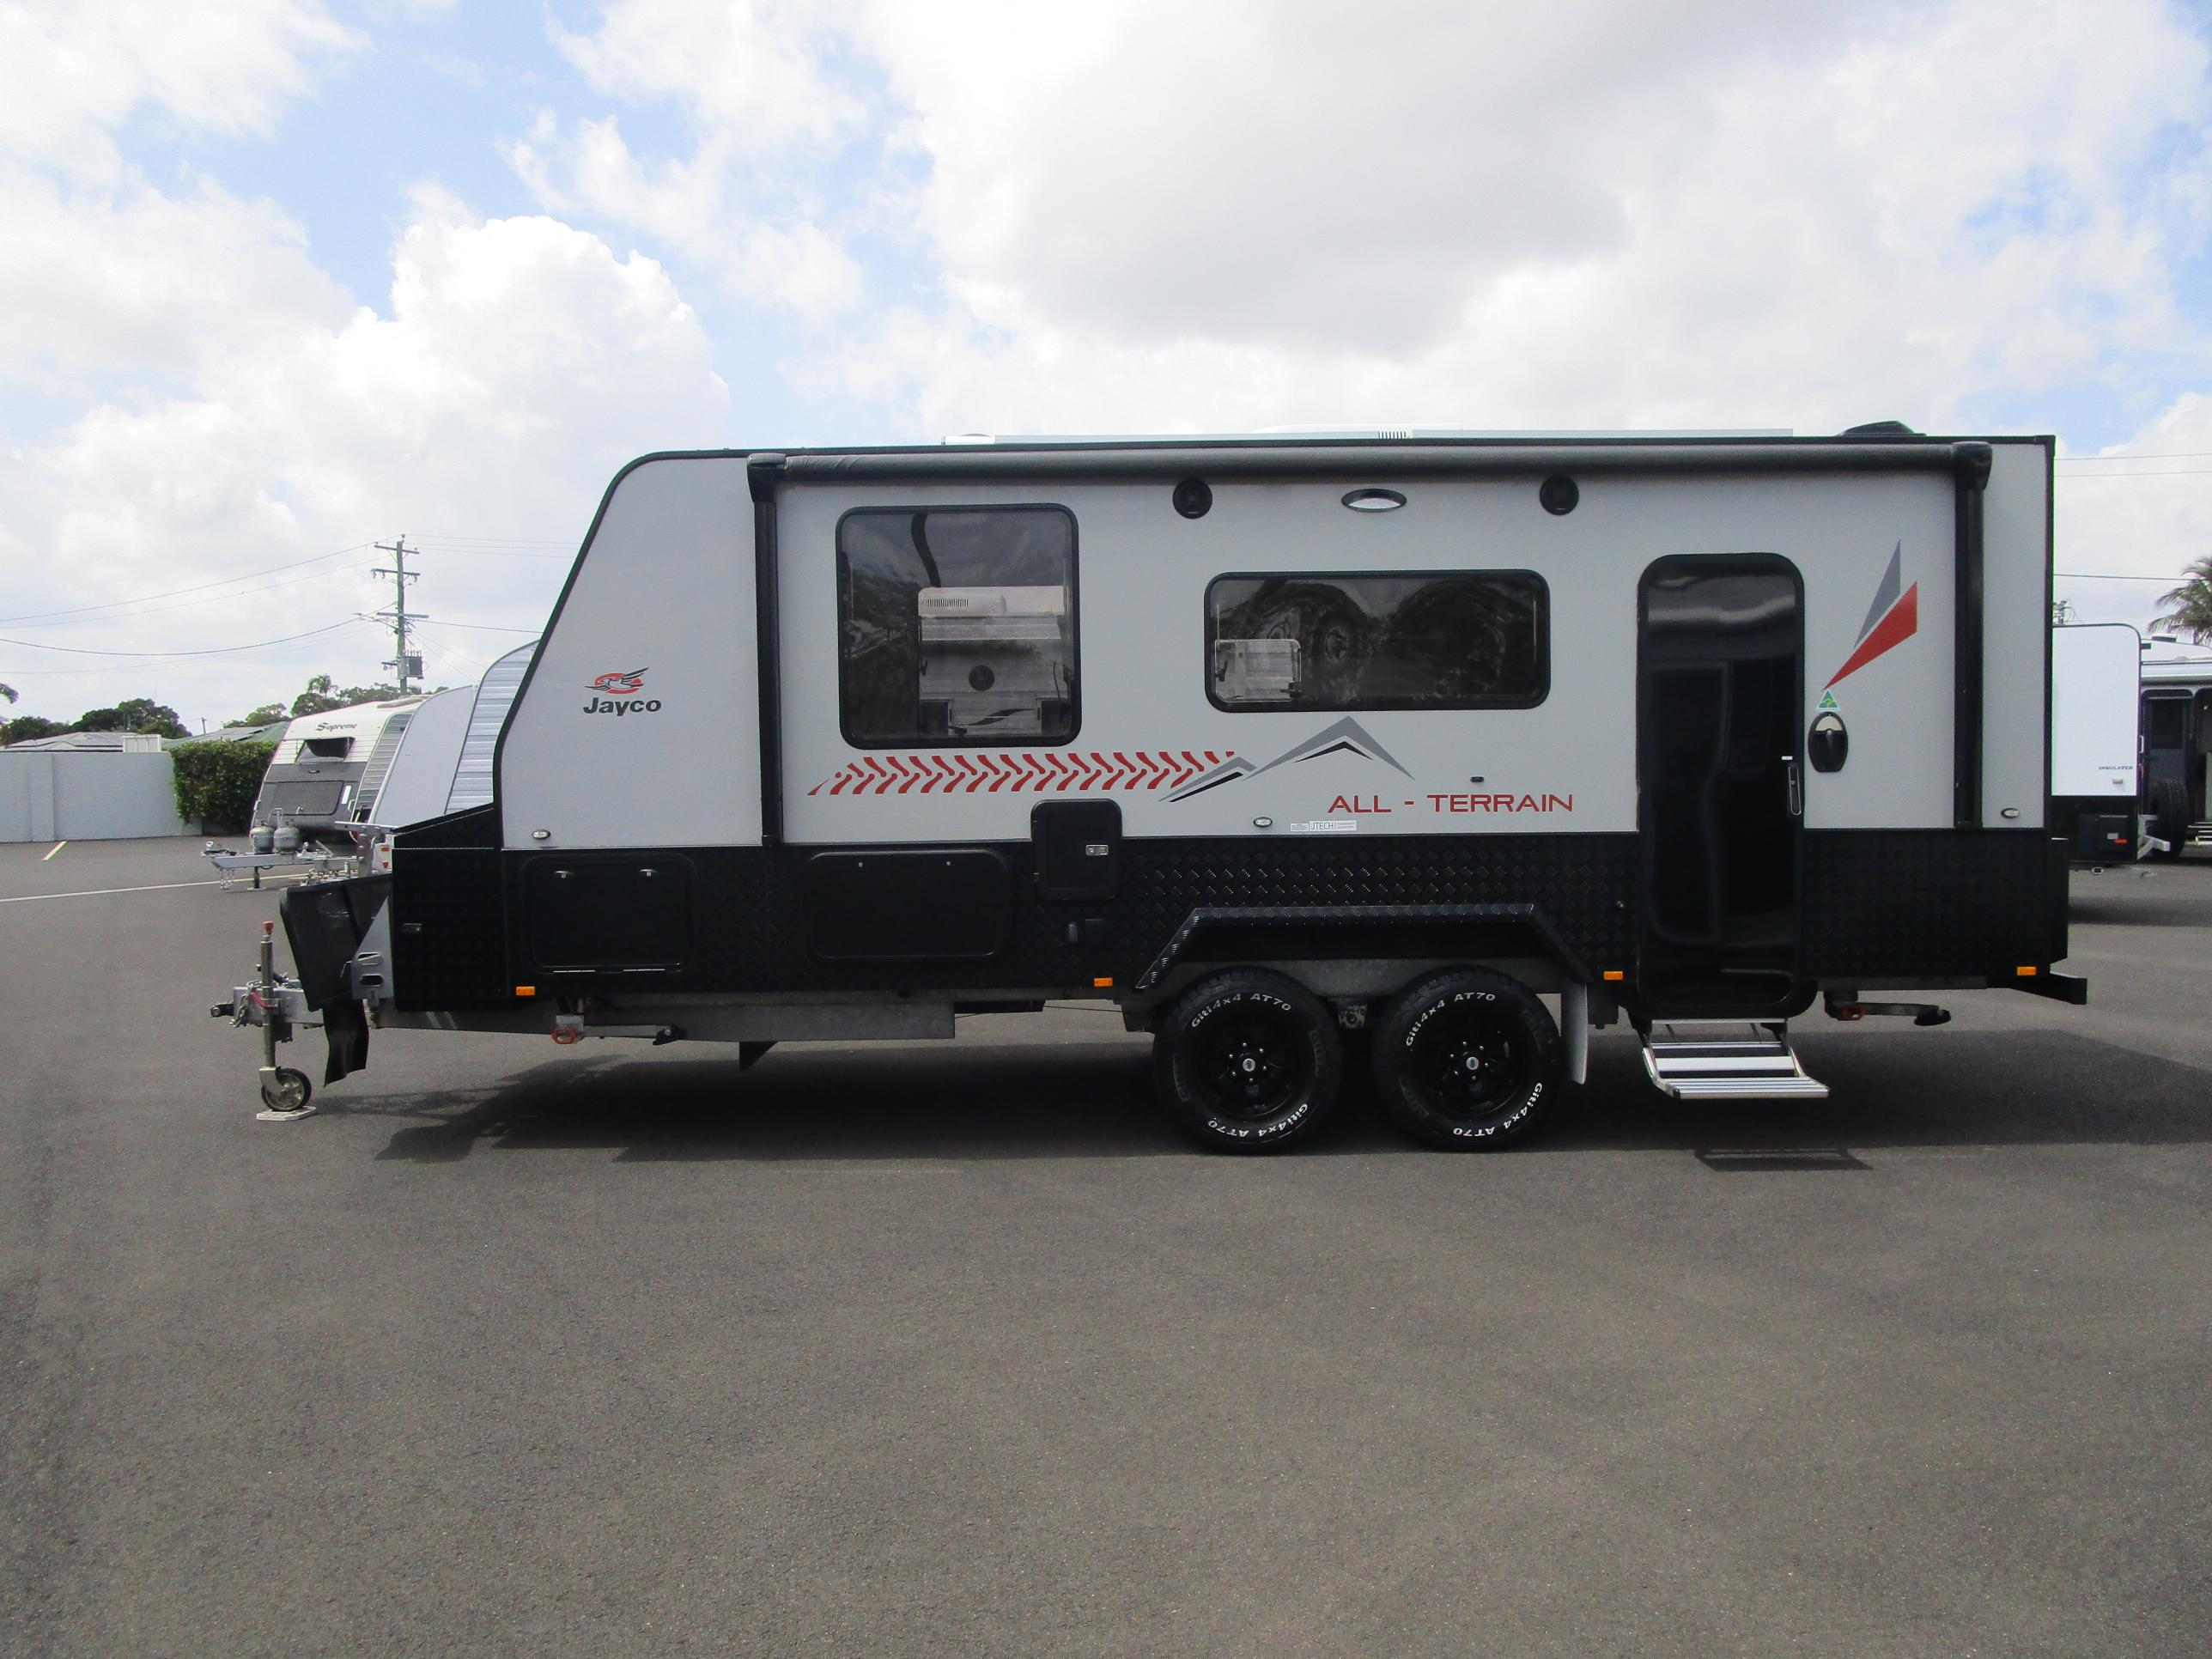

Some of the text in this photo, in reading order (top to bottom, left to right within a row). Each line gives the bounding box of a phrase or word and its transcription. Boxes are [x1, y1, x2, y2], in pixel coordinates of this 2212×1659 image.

[583, 697, 662, 717] Jayco
[315, 722, 357, 732] Supreme
[1328, 794, 1392, 813] ALL
[1427, 794, 1573, 812] TERRAIN
[1249, 993, 1291, 1011] AT70
[1454, 992, 1496, 1002] AT70
[1207, 1120, 1249, 1137] AT70
[1453, 1126, 1495, 1137] AT70
